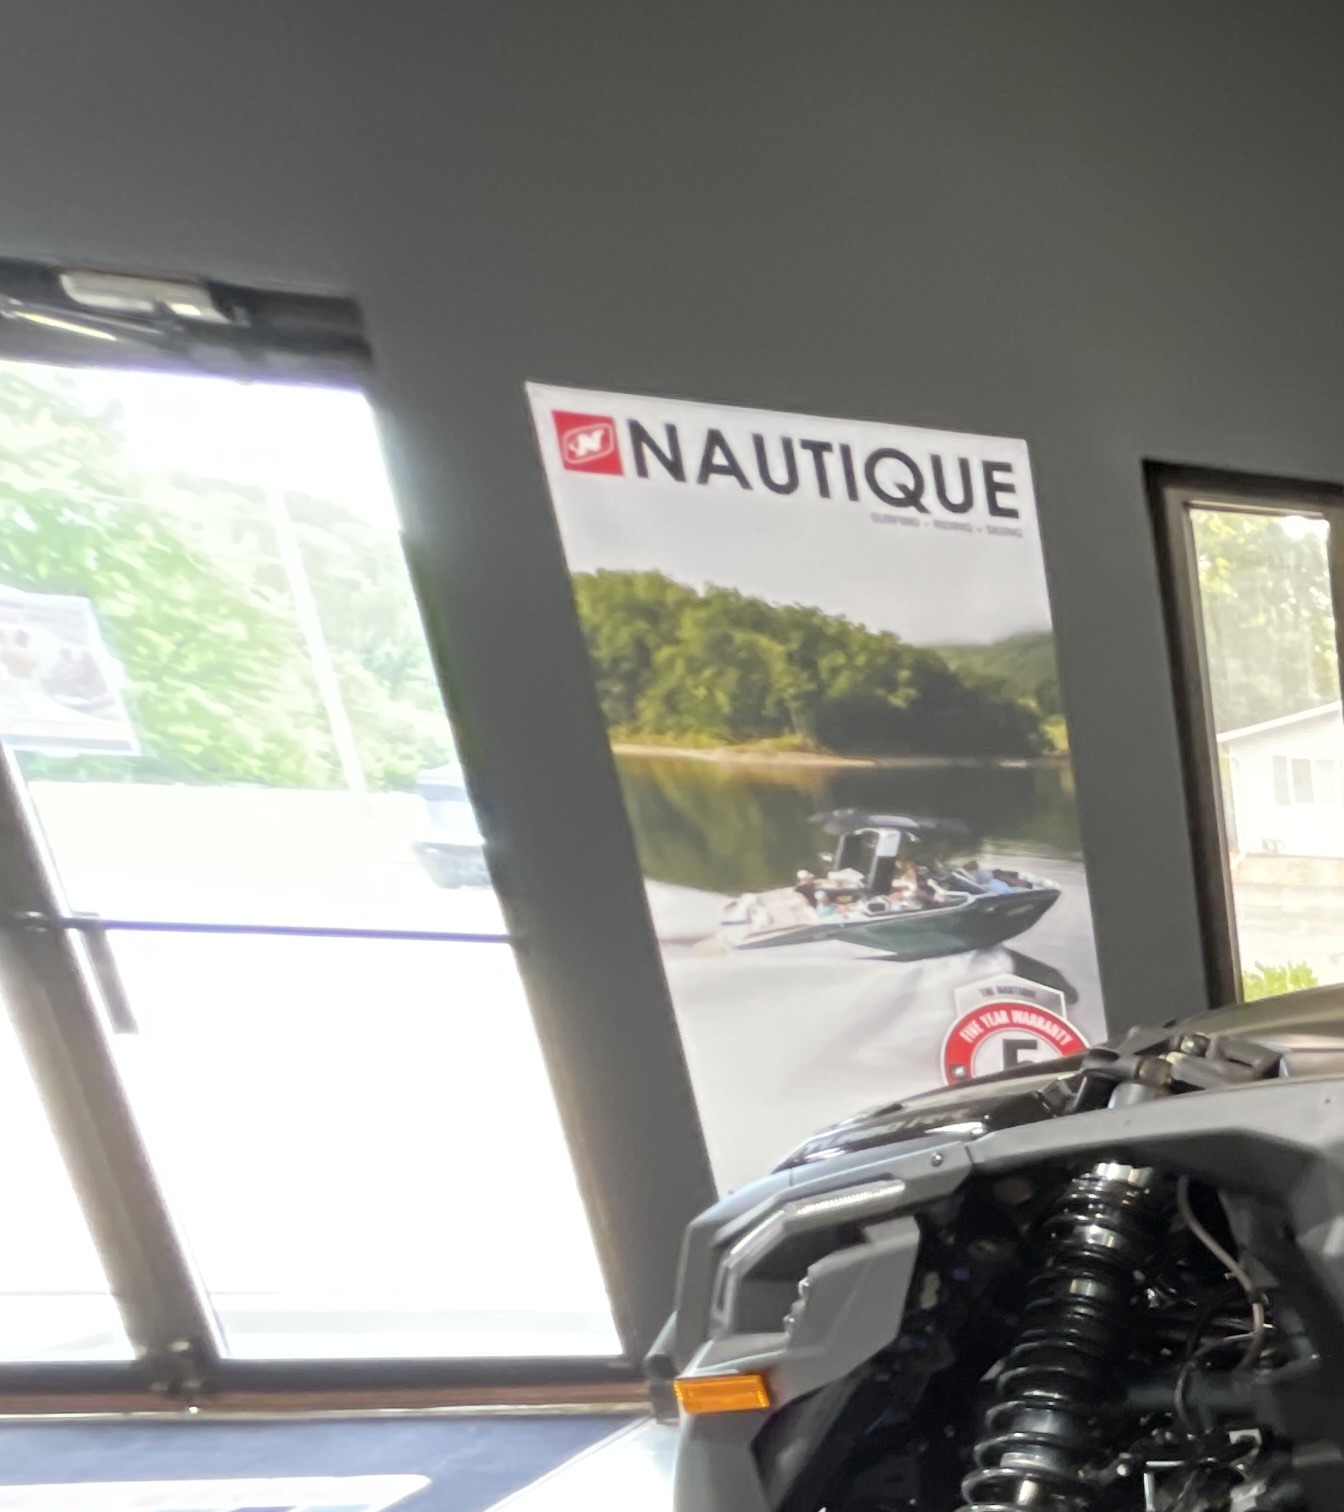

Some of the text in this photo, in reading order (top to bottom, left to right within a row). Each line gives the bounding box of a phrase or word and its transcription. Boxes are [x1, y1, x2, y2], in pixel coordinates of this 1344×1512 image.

[628, 418, 1021, 520] NAUTIQUE
[959, 1009, 1073, 1046] FIVE YEAR WARRANTY
